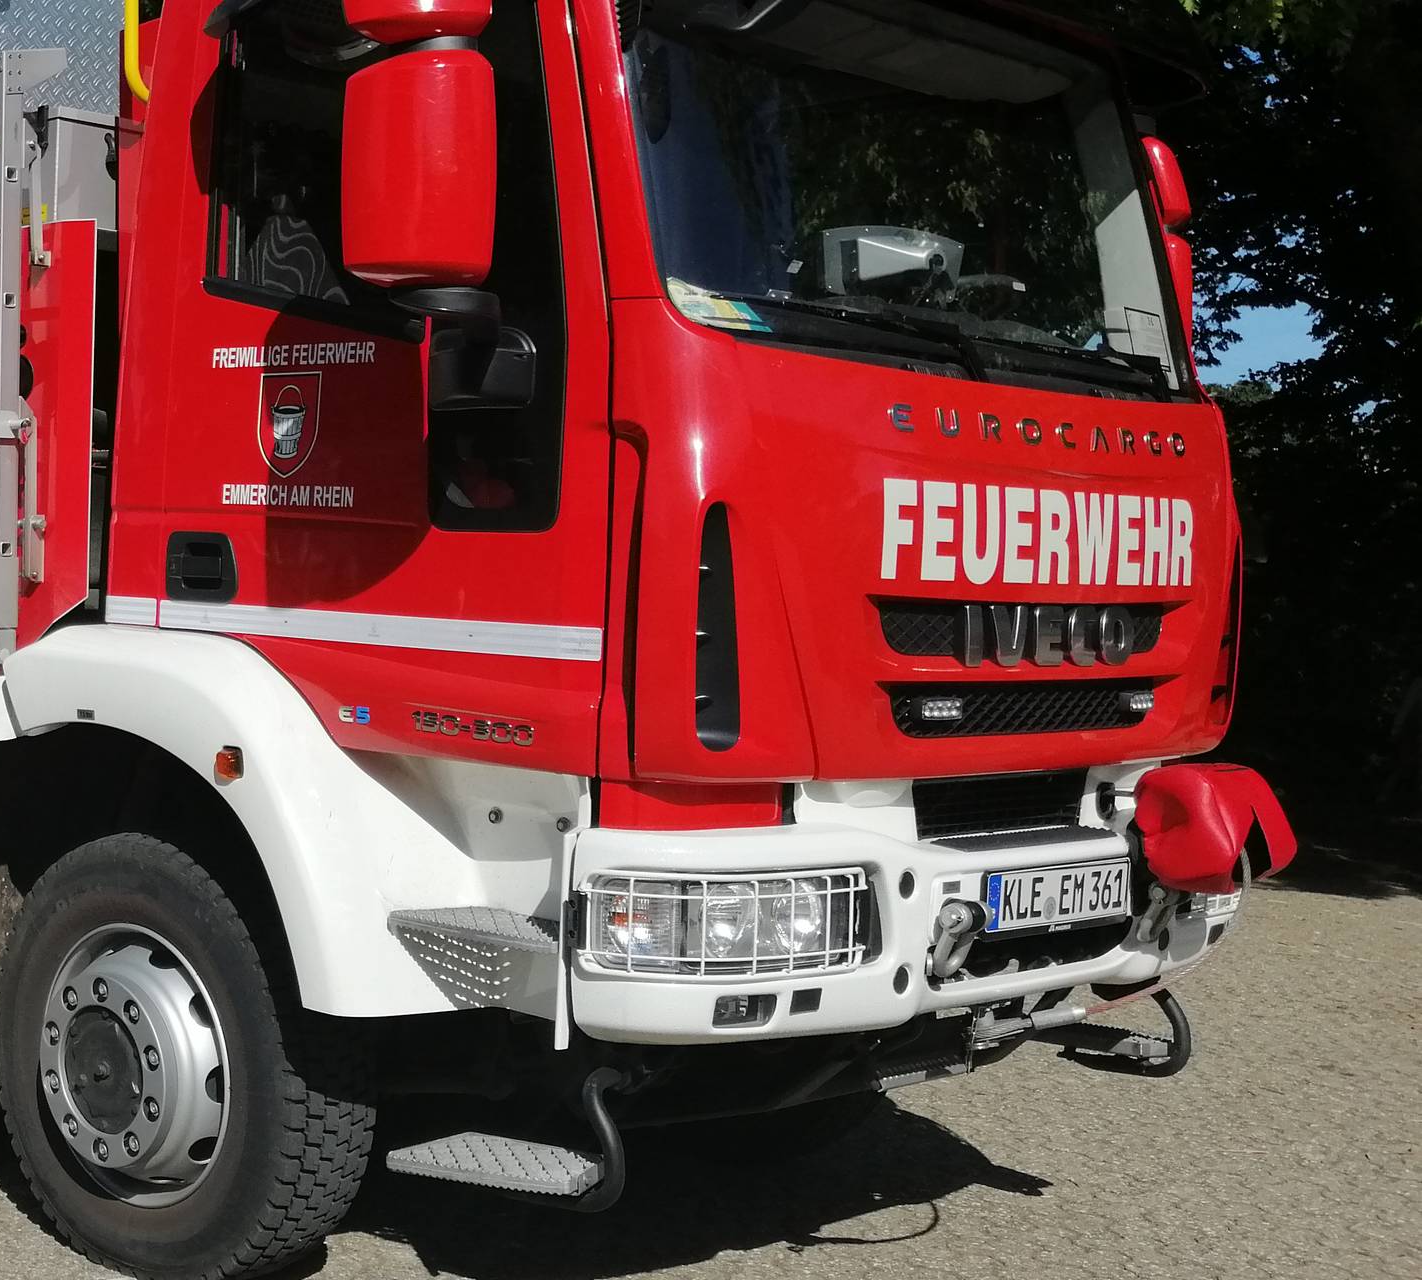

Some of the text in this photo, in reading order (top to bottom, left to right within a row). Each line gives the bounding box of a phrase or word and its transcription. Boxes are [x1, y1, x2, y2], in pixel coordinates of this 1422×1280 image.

[212, 342, 375, 369] FREIWILLIGE FEUERWEHR
[887, 403, 1186, 457] EUROCARGO
[222, 484, 354, 508] EMMERICH AM RHEIN
[880, 478, 1194, 587] FEUERWEHR
[962, 604, 1135, 668] IVECO
[338, 706, 371, 725] E5
[411, 710, 536, 747] 150-300
[1002, 868, 1124, 921] KLE EM 361
